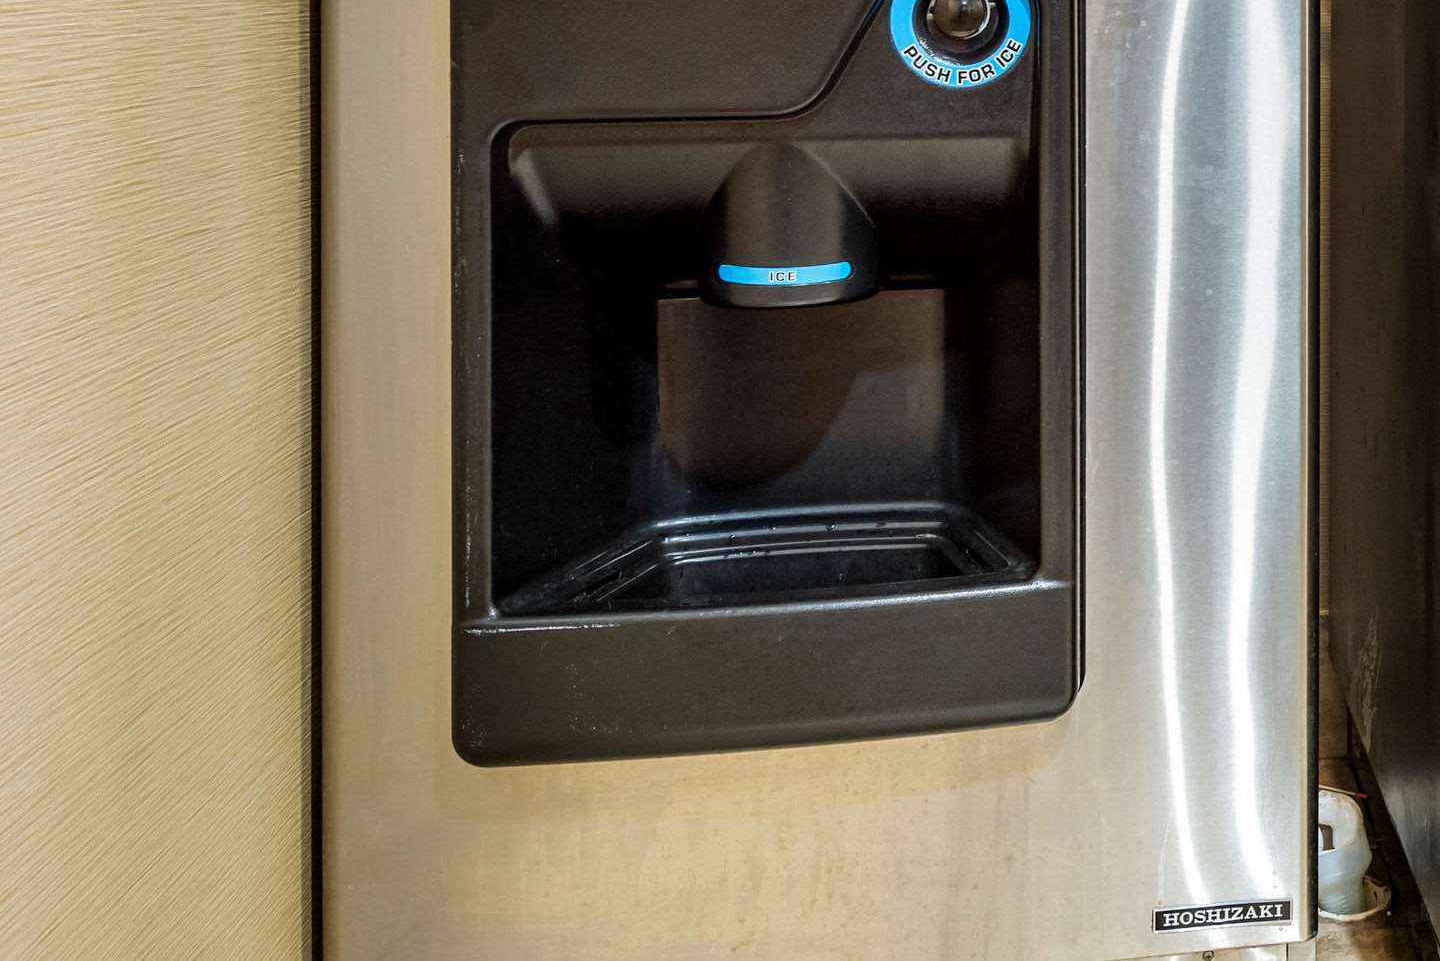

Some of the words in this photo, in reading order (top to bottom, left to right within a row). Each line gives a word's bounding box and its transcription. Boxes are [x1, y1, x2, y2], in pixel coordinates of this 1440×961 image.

[903, 45, 951, 83] PUSH
[957, 63, 995, 84] FOR
[995, 39, 1022, 68] ICE
[769, 272, 796, 281] ICE
[1163, 904, 1284, 927] HOSHIZAKI
